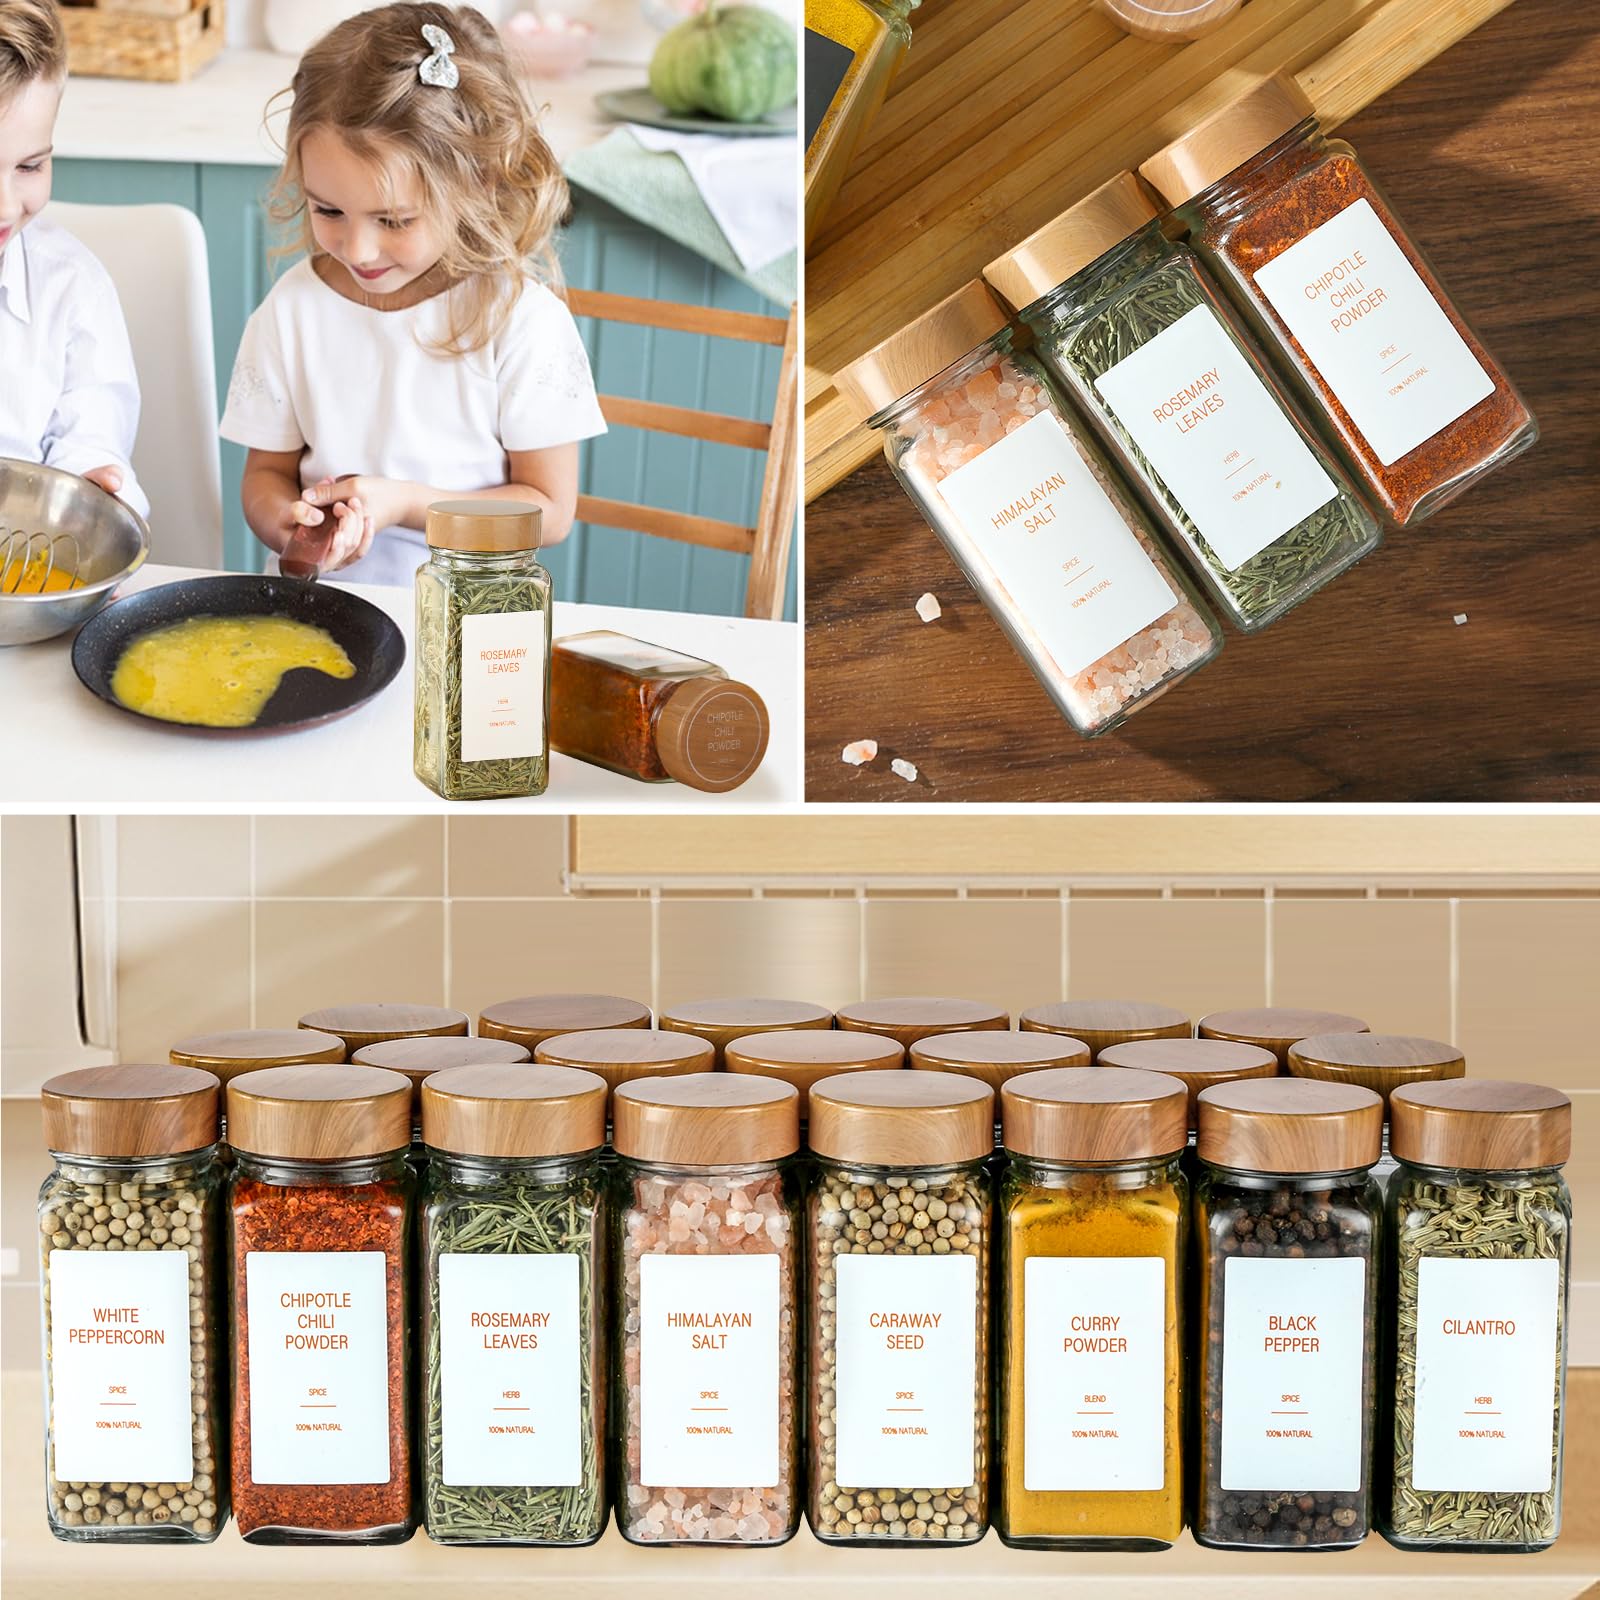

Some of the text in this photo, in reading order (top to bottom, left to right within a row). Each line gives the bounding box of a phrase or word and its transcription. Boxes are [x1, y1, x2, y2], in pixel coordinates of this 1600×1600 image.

[1304, 250, 1367, 300] CHIPOTLE
[1330, 278, 1366, 308] CHILI
[1330, 288, 1388, 333] POWDER
[1379, 344, 1397, 359] SPICE
[1388, 366, 1429, 396] 100% NATURAL
[1152, 367, 1221, 423] ROSEMARY
[1175, 393, 1225, 434] LEAVES
[1224, 450, 1240, 464] HERB
[1232, 472, 1272, 502] 100% NATURAL
[991, 472, 1066, 530] HIMALAYAN
[1024, 503, 1057, 534] SALT
[1062, 556, 1080, 572] SPICE
[1071, 579, 1112, 609] 100% NATURAL
[480, 648, 527, 661] ROSEMARY
[487, 662, 520, 674] LEAVES
[280, 1293, 350, 1308] CHIPOTLE
[93, 1308, 139, 1323] WHITE
[297, 1314, 335, 1329] CHILI
[471, 1312, 549, 1327] ROSEMARY
[667, 1313, 752, 1328] HIMALAYAN
[869, 1313, 941, 1328] CARAWAY
[1071, 1316, 1120, 1331] CURRY
[1268, 1316, 1316, 1331] BLACK
[1443, 1320, 1516, 1335] CILANTRO
[68, 1329, 165, 1344] PEPPERCORN
[285, 1335, 349, 1349] POWDER
[483, 1334, 537, 1349] LEAVES
[692, 1334, 727, 1349] SALT
[887, 1335, 925, 1349] SEED
[1063, 1338, 1127, 1352] POWDER
[1264, 1337, 1320, 1352] PEPPER
[110, 1385, 127, 1394] SPICE
[308, 1387, 326, 1396] SPICE
[503, 1390, 521, 1399] HERB
[699, 1391, 719, 1400] SPICE
[895, 1391, 914, 1400] SPICE
[1083, 1394, 1106, 1404] BLEND
[1281, 1394, 1300, 1403] SPICE
[1473, 1396, 1493, 1405] HERB
[95, 1420, 142, 1429] 100% NATURAL
[296, 1423, 342, 1432] 100% NATURAL
[488, 1425, 535, 1434] 100% NATURAL
[687, 1425, 733, 1435] 100% NATURAL
[881, 1427, 929, 1436] 100% NATURAL
[1071, 1430, 1119, 1438] 100% NATURAL
[1267, 1429, 1313, 1438] 100% NATURAL
[1459, 1430, 1506, 1439] 100% NATURAL
